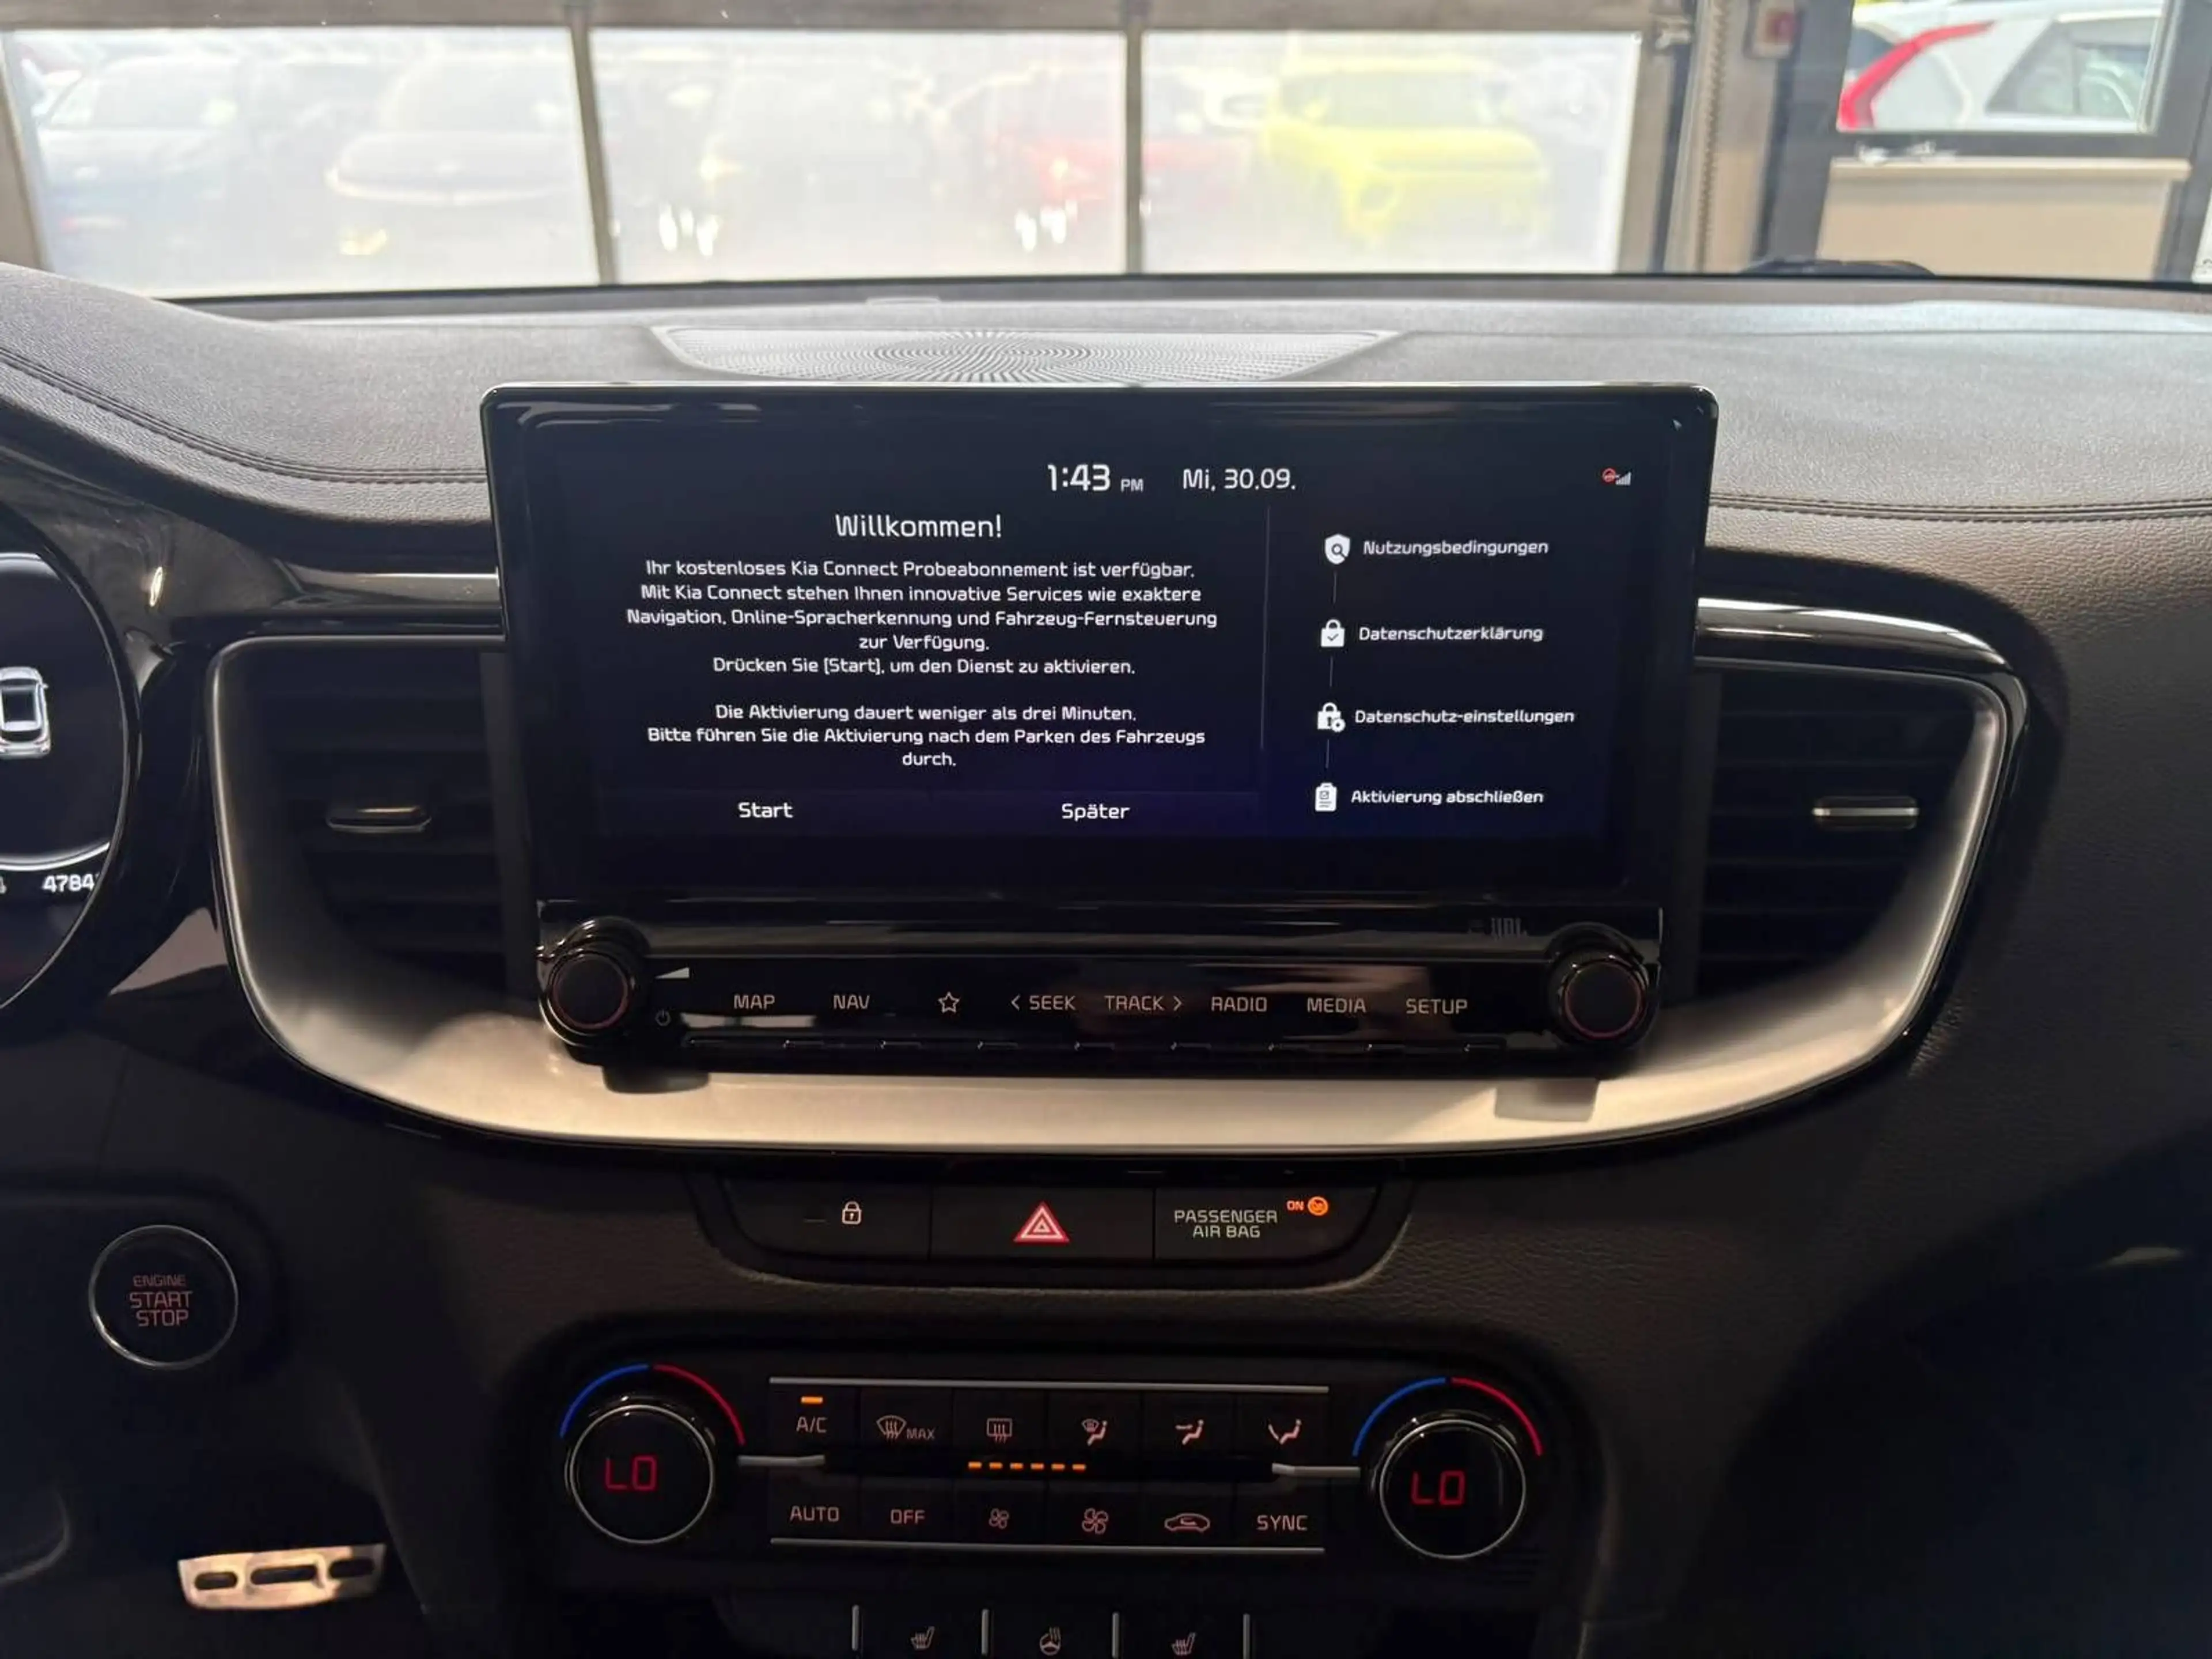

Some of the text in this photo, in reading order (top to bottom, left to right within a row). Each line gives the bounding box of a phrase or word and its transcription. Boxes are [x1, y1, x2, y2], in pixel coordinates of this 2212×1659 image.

[1047, 464, 1143, 492] 1:43 PM
[1183, 468, 1296, 491] Mi, 30.09.
[835, 514, 1001, 538] Willkommen!
[1363, 540, 1549, 557] Nutzungsbedingungen
[646, 559, 1194, 579] Ihr kostenloses Kia Connect Probeabonnement ist verfügbar.
[641, 584, 1202, 602] Mit Kia Connect stehen Ihnen innovative Services wie exaktere
[731, 609, 952, 628] Online-Spracherkennung
[957, 611, 990, 626] und
[995, 611, 1217, 628] Fahrzeug-Fernsteuerung
[1359, 626, 1543, 642] Datenschutzerklärung
[859, 634, 990, 652] zur Verfügung.
[713, 657, 787, 672] Drücken
[791, 657, 819, 673] Sie
[890, 661, 915, 673] um
[919, 658, 952, 673] den
[957, 658, 1014, 673] Dienst
[1018, 662, 1038, 673] zu
[1043, 659, 1135, 675] aktivieren.
[715, 704, 1137, 723] Die Aktivierung dauert weniger als drei Minuten.
[1355, 709, 1575, 725] Datenschutz-einstellungen
[647, 727, 1205, 746] Bitte führen Sie die Aktivierung nach dem Parken des Fahrzeugs
[902, 752, 956, 767] durch.
[1351, 790, 1544, 805] Aktivierung abschließen
[738, 802, 793, 819] Start
[1062, 802, 1130, 821] Später
[41, 872, 101, 892] 4784
[734, 994, 775, 1009] MAP
[833, 994, 870, 1009] NAV
[1029, 995, 1076, 1010] SEEK
[1104, 995, 1164, 1011] TRACK
[1211, 996, 1267, 1012] RADIO
[1307, 995, 1366, 1013] MEDIA
[1406, 998, 1468, 1014] SETUP
[1287, 1200, 1305, 1211] ON
[1174, 1209, 1278, 1224] PASSENGER
[1192, 1225, 1260, 1238] AIR BAG
[132, 1274, 185, 1287] ENGINE
[129, 1291, 192, 1308] START
[135, 1309, 189, 1327] STOP
[796, 1416, 827, 1433] A/C
[906, 1427, 934, 1440] MAX
[790, 1505, 839, 1522] AUTO
[890, 1509, 925, 1524] OFF
[1257, 1514, 1307, 1531] SYNC
